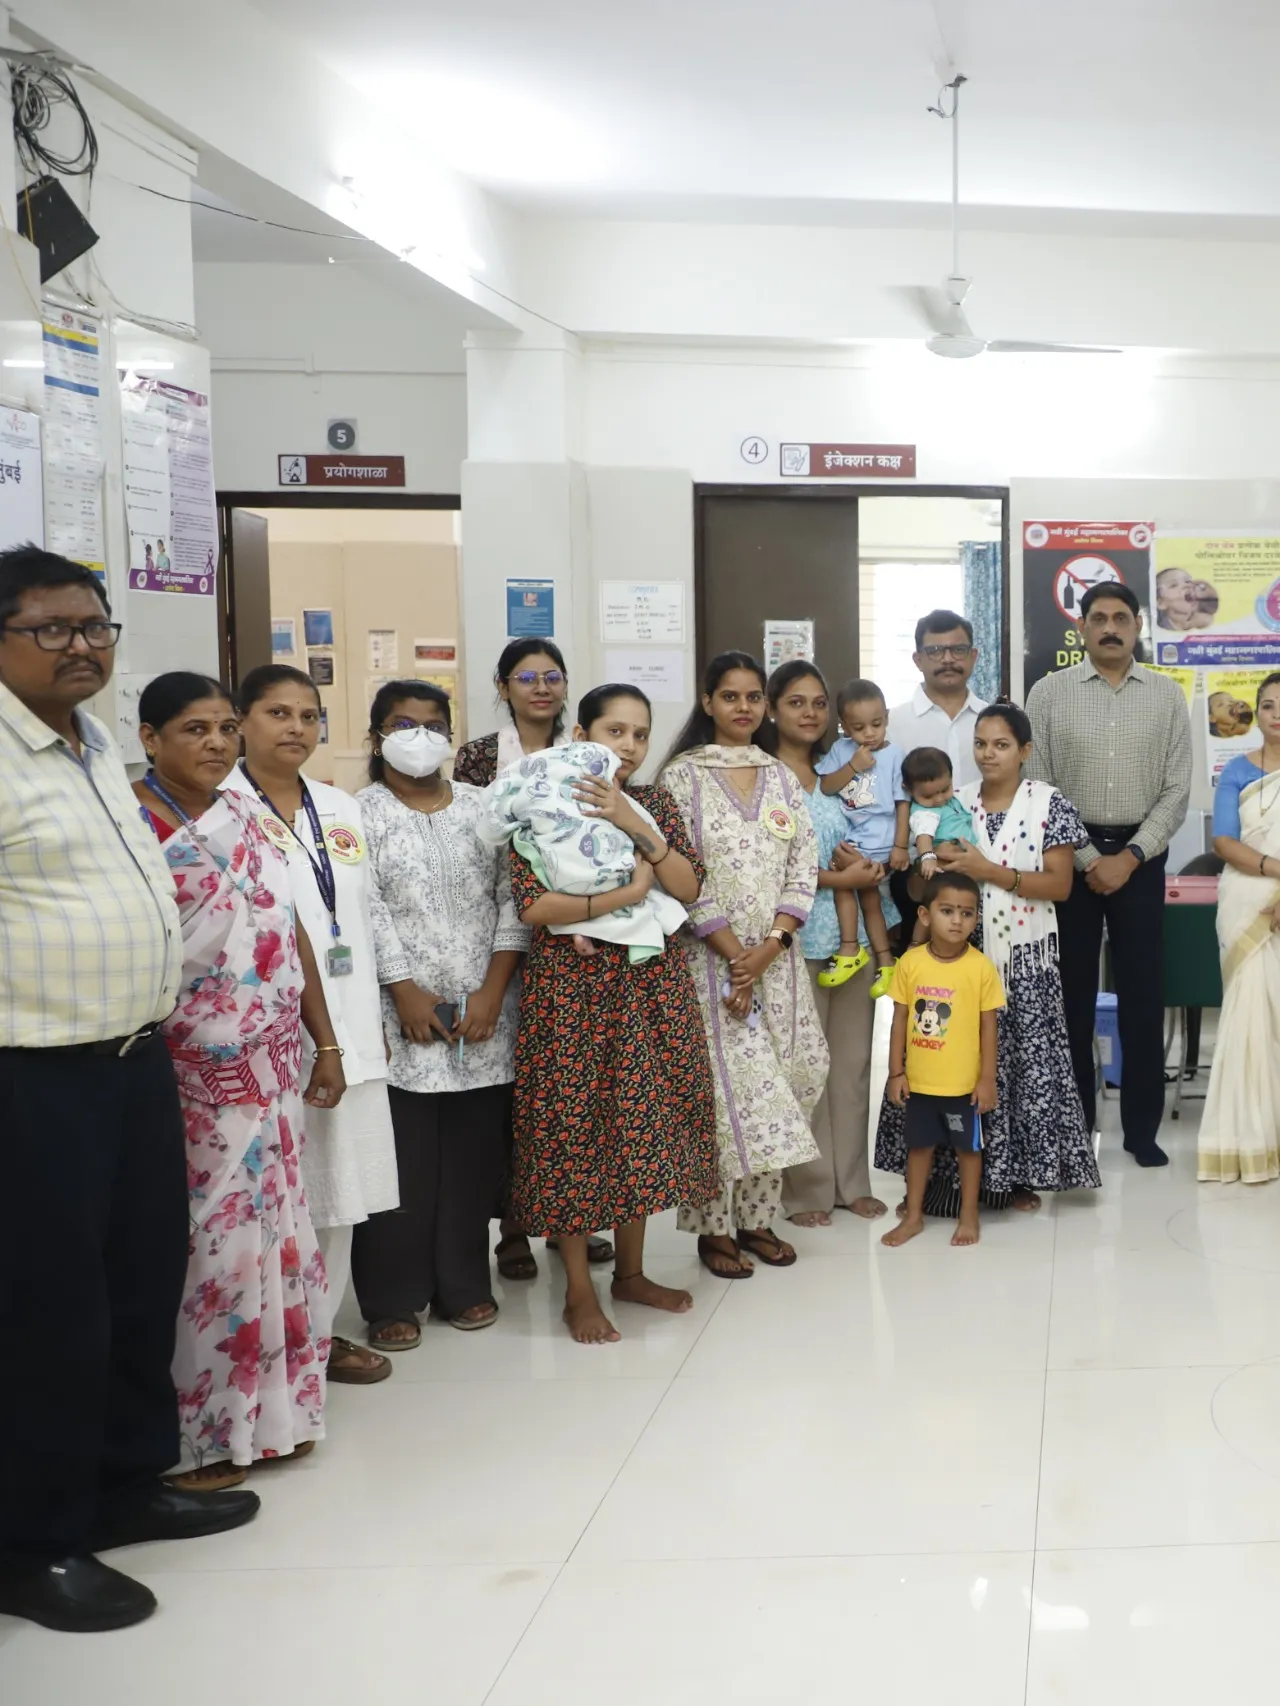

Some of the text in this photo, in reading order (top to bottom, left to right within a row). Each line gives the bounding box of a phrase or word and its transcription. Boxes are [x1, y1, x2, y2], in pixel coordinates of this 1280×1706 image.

[336, 429, 347, 443] 5
[748, 442, 760, 458] 4
[824, 450, 902, 470] इंजेक्शन कक्ष
[323, 462, 388, 479] प्रयोगशाळा
[915, 985, 957, 999] MICKEY
[911, 1037, 946, 1051] MICKEY
